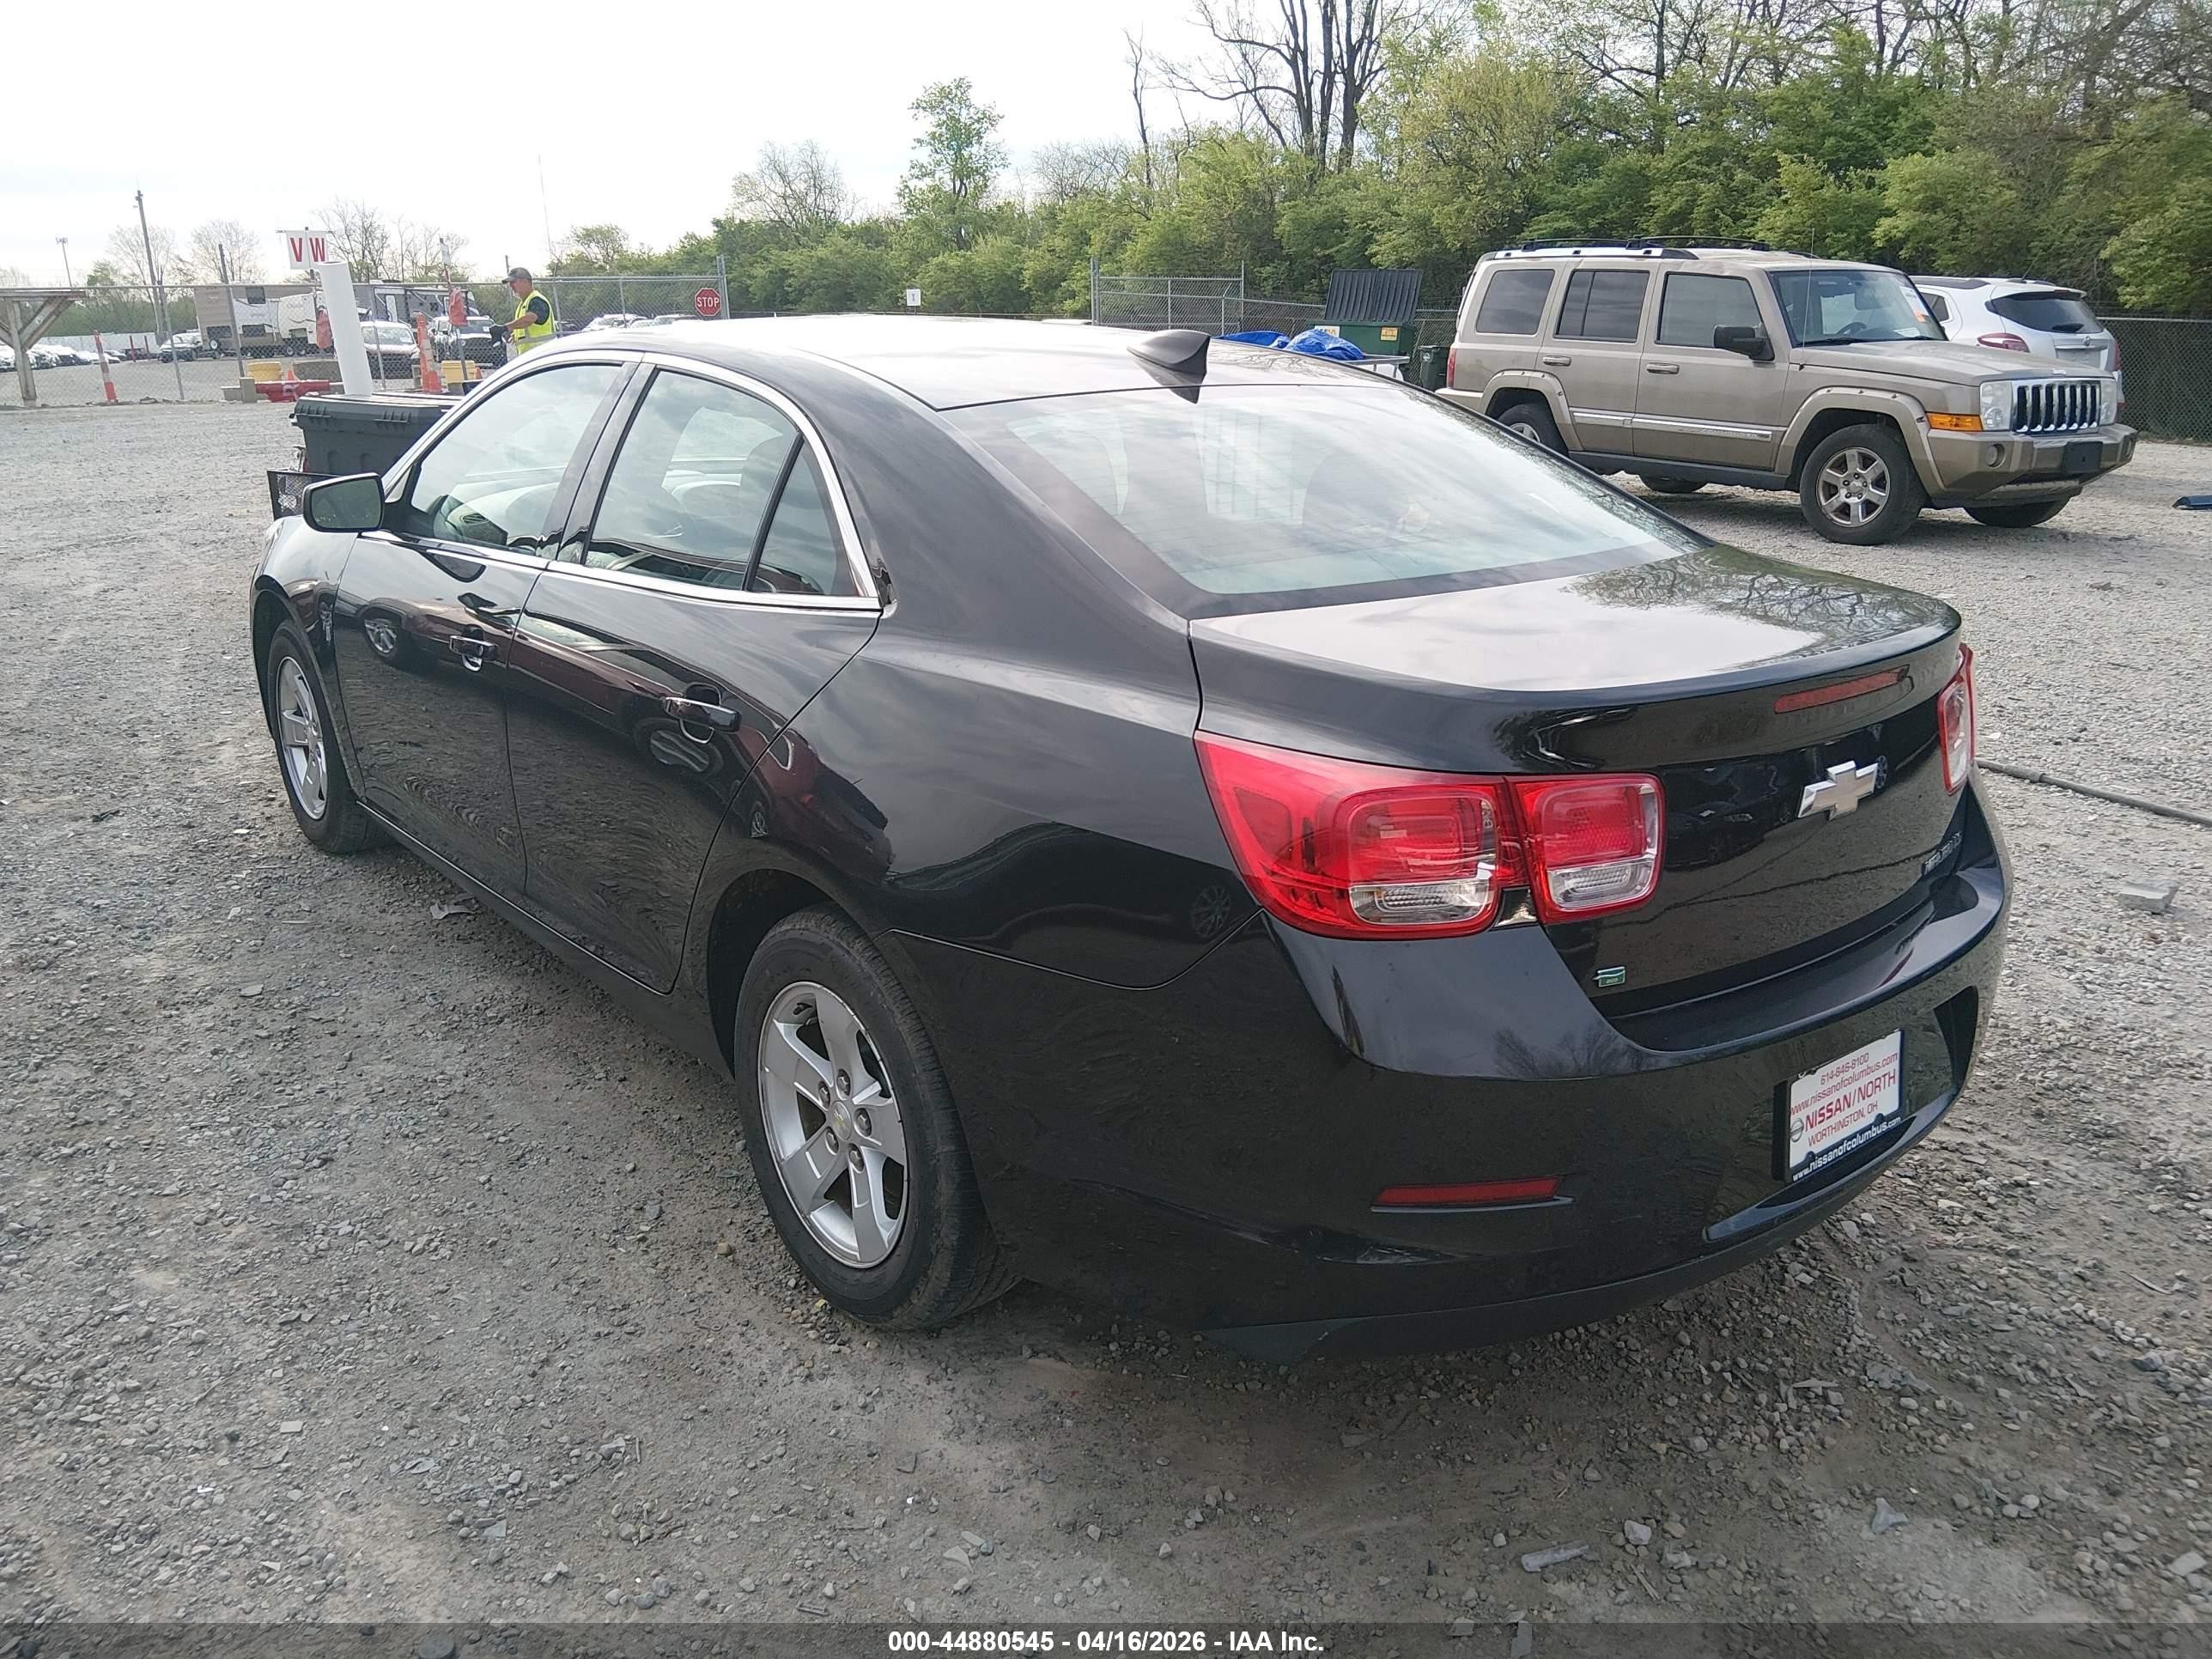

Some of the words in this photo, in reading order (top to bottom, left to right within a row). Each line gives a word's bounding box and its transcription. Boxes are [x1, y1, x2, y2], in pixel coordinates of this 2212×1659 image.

[289, 237, 303, 263] V
[308, 237, 325, 263] W
[696, 296, 720, 307] STOP
[1790, 1053, 1898, 1115] www.nissanofcolumbus.com
[1820, 1052, 1869, 1085] 614-846-8100
[1808, 1109, 1866, 1146] WORTHINGTON,
[1867, 1100, 1878, 1115] OH
[1793, 1117, 1900, 1182] www.nissanofcolumbus.com
